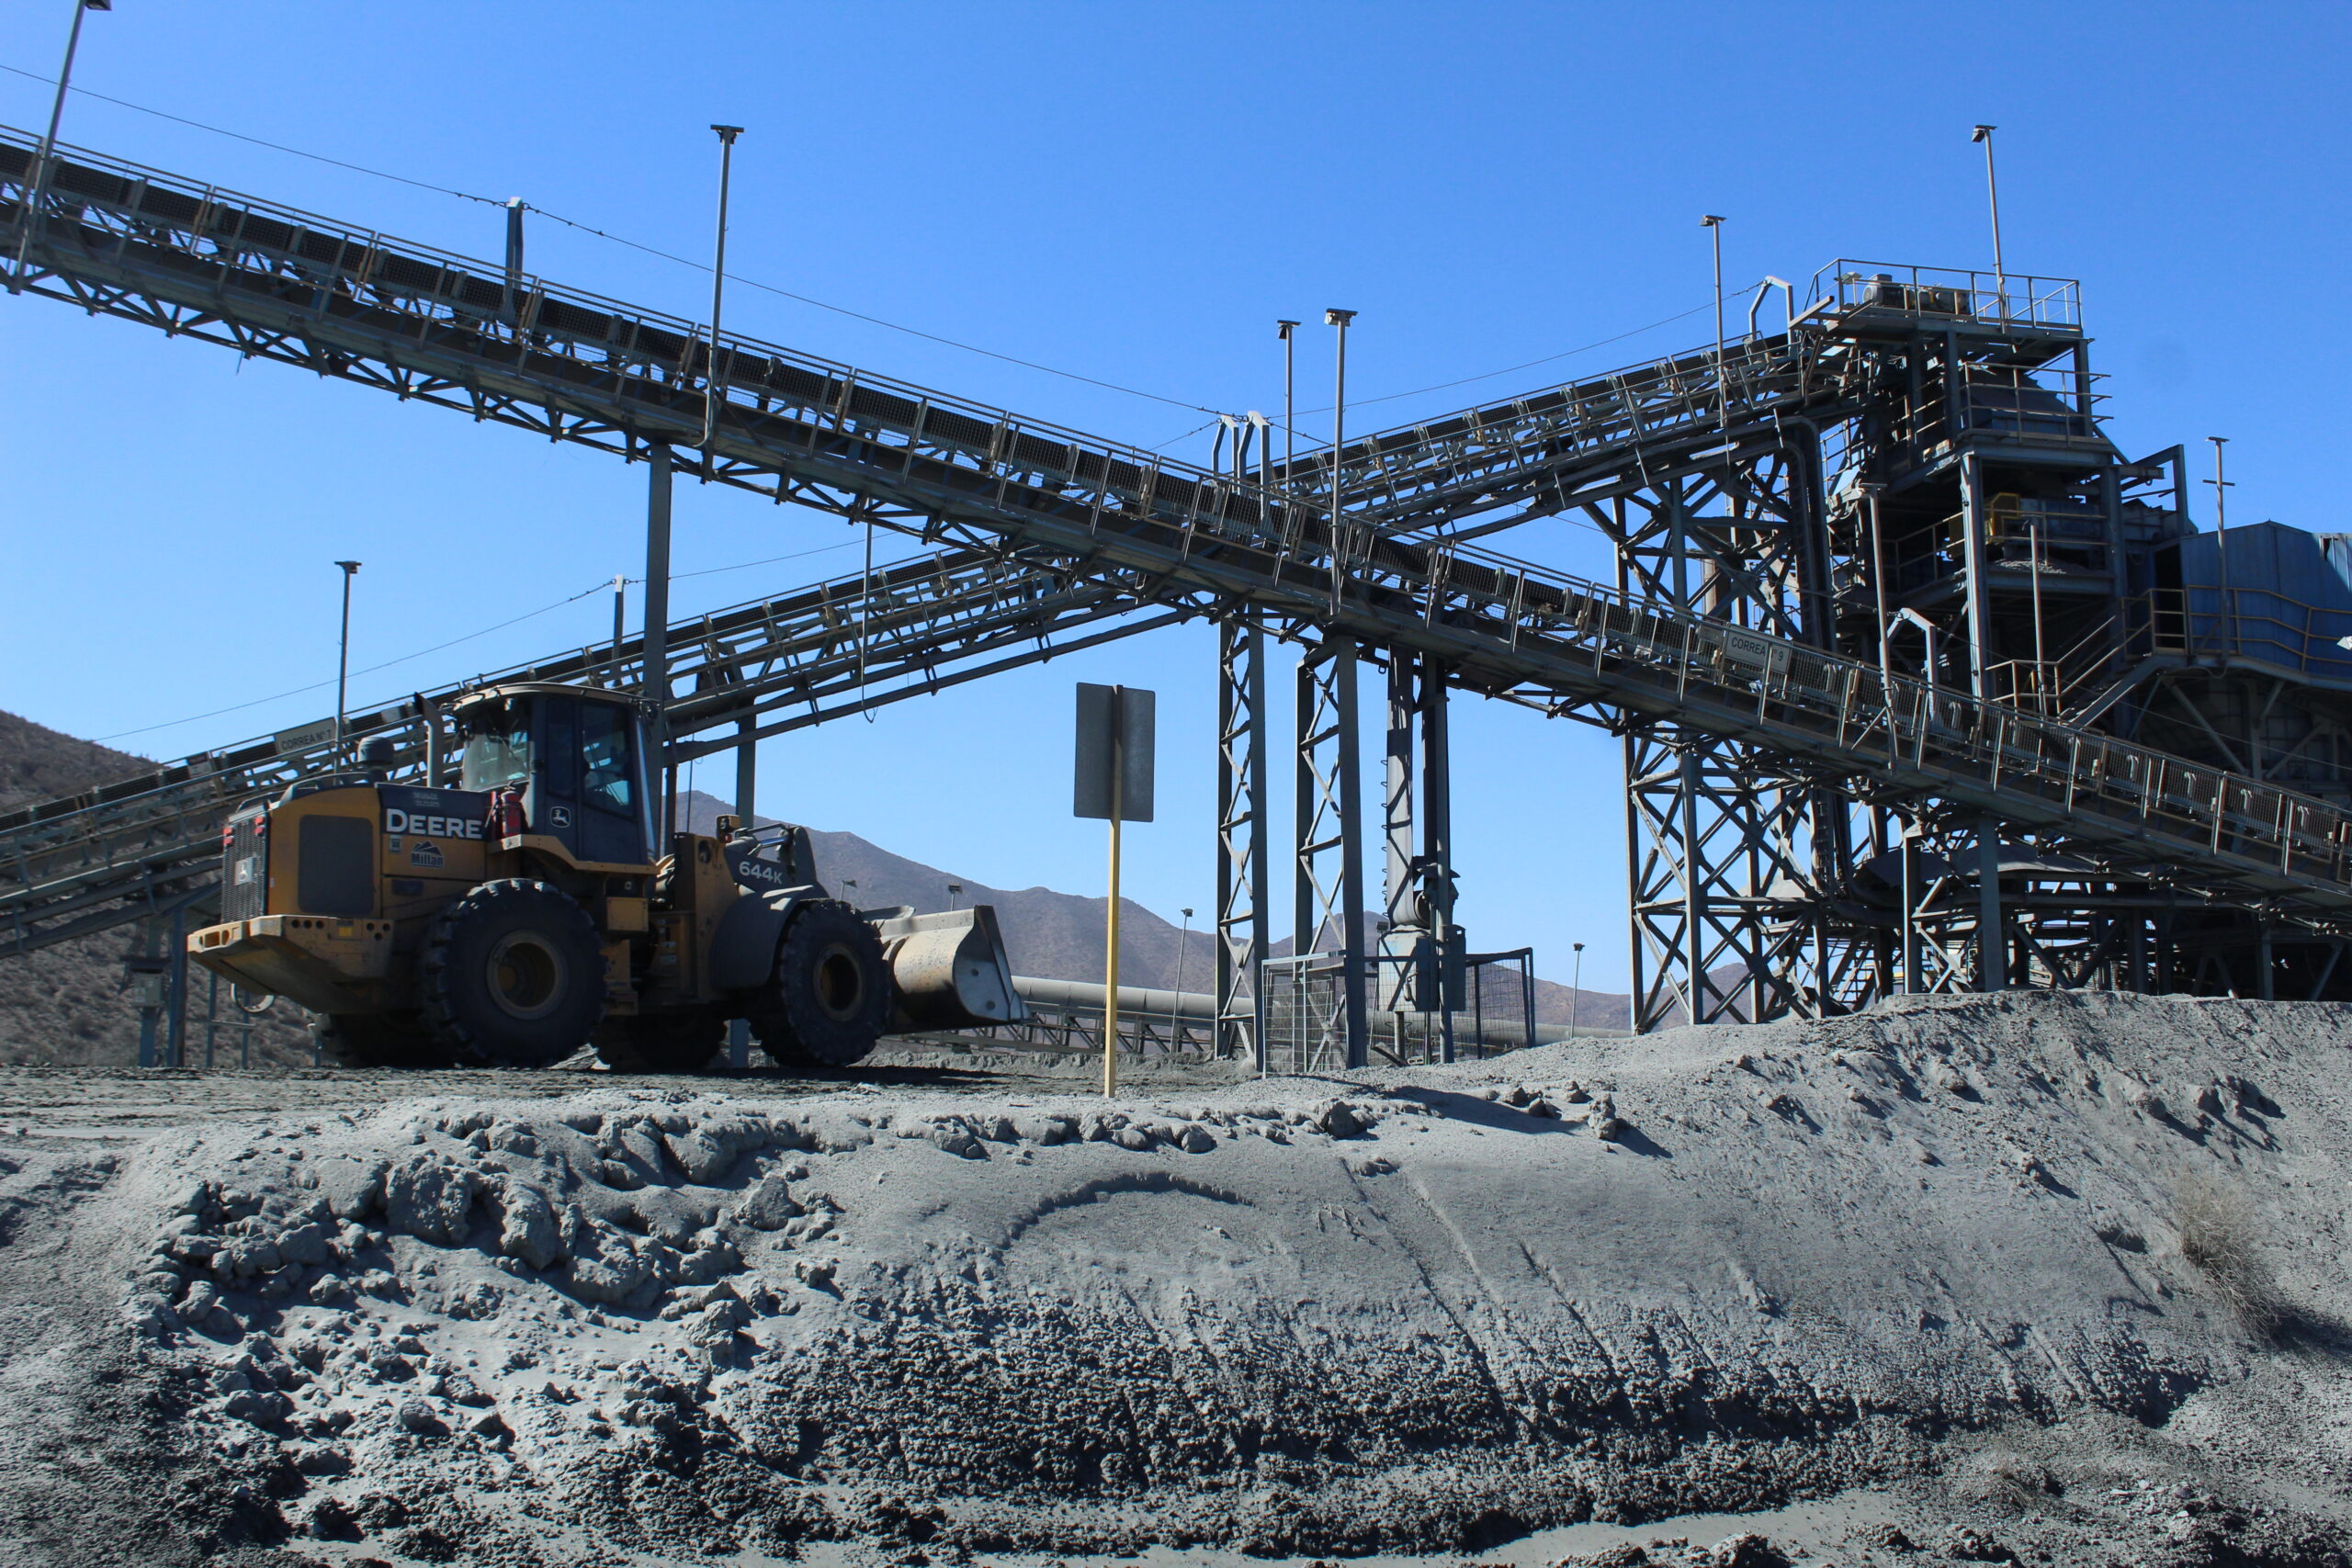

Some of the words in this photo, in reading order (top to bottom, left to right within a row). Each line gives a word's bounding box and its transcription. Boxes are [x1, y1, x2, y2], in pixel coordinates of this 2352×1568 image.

[1731, 637, 1766, 657] CORREA
[1778, 650, 1784, 662] 9
[281, 734, 317, 750] CORREA
[386, 807, 483, 840] DEERE
[739, 861, 783, 885] 644K
